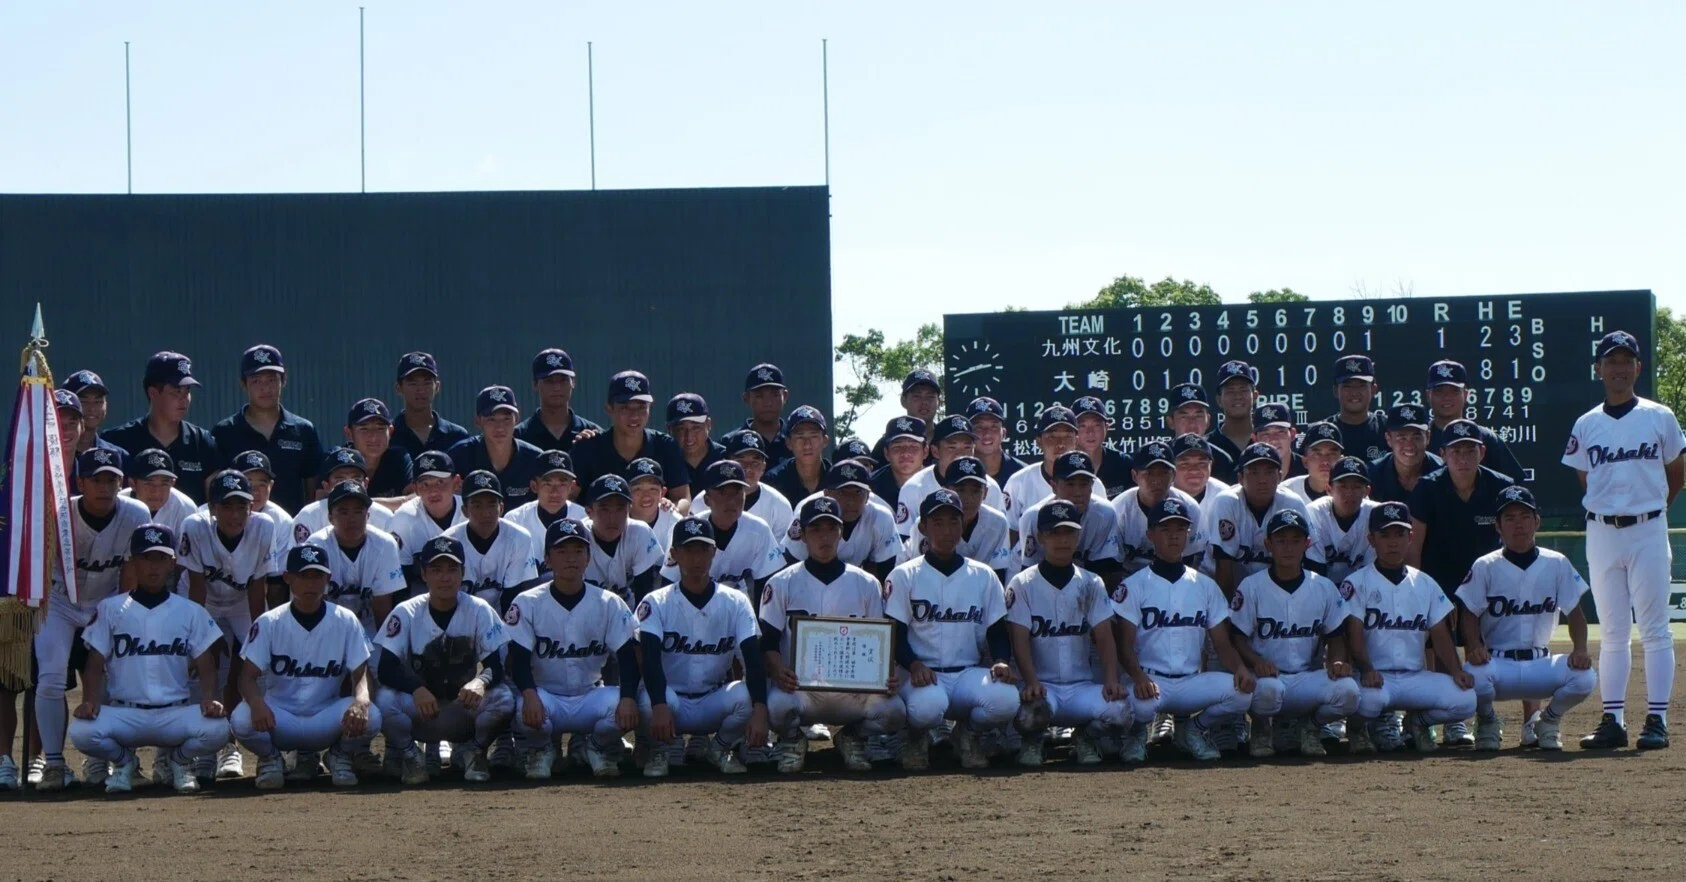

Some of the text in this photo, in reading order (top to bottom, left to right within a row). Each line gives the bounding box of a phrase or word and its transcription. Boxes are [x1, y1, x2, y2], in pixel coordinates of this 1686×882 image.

[1059, 301, 1522, 334] TEAM 1 2 3 4 5 6 7 8 9 10 R H E
[1532, 319, 1544, 334] B
[1591, 316, 1603, 332] H
[1042, 337, 1121, 356] 九州文化
[1481, 326, 1491, 347] 2
[1510, 325, 1521, 346] 3
[1533, 342, 1544, 358] S
[1054, 370, 1109, 392] 大崎
[1481, 359, 1492, 380] 8
[1122, 399, 1133, 414] 7
[1140, 399, 1150, 414] 8
[1158, 398, 1169, 413] 9
[1485, 388, 1495, 403] 7
[1503, 388, 1513, 403] 8
[1521, 387, 1532, 402] 9
[1123, 417, 1133, 430] 8
[1140, 416, 1151, 429] 5
[1484, 406, 1494, 419] 7
[1503, 406, 1514, 418] 4
[1586, 442, 1659, 468] Ohsaki
[910, 599, 984, 625] Ohsaki
[1030, 614, 1088, 638] Ohsak
[113, 633, 189, 659] Ohsaki
[661, 631, 735, 655] Ohsaki
